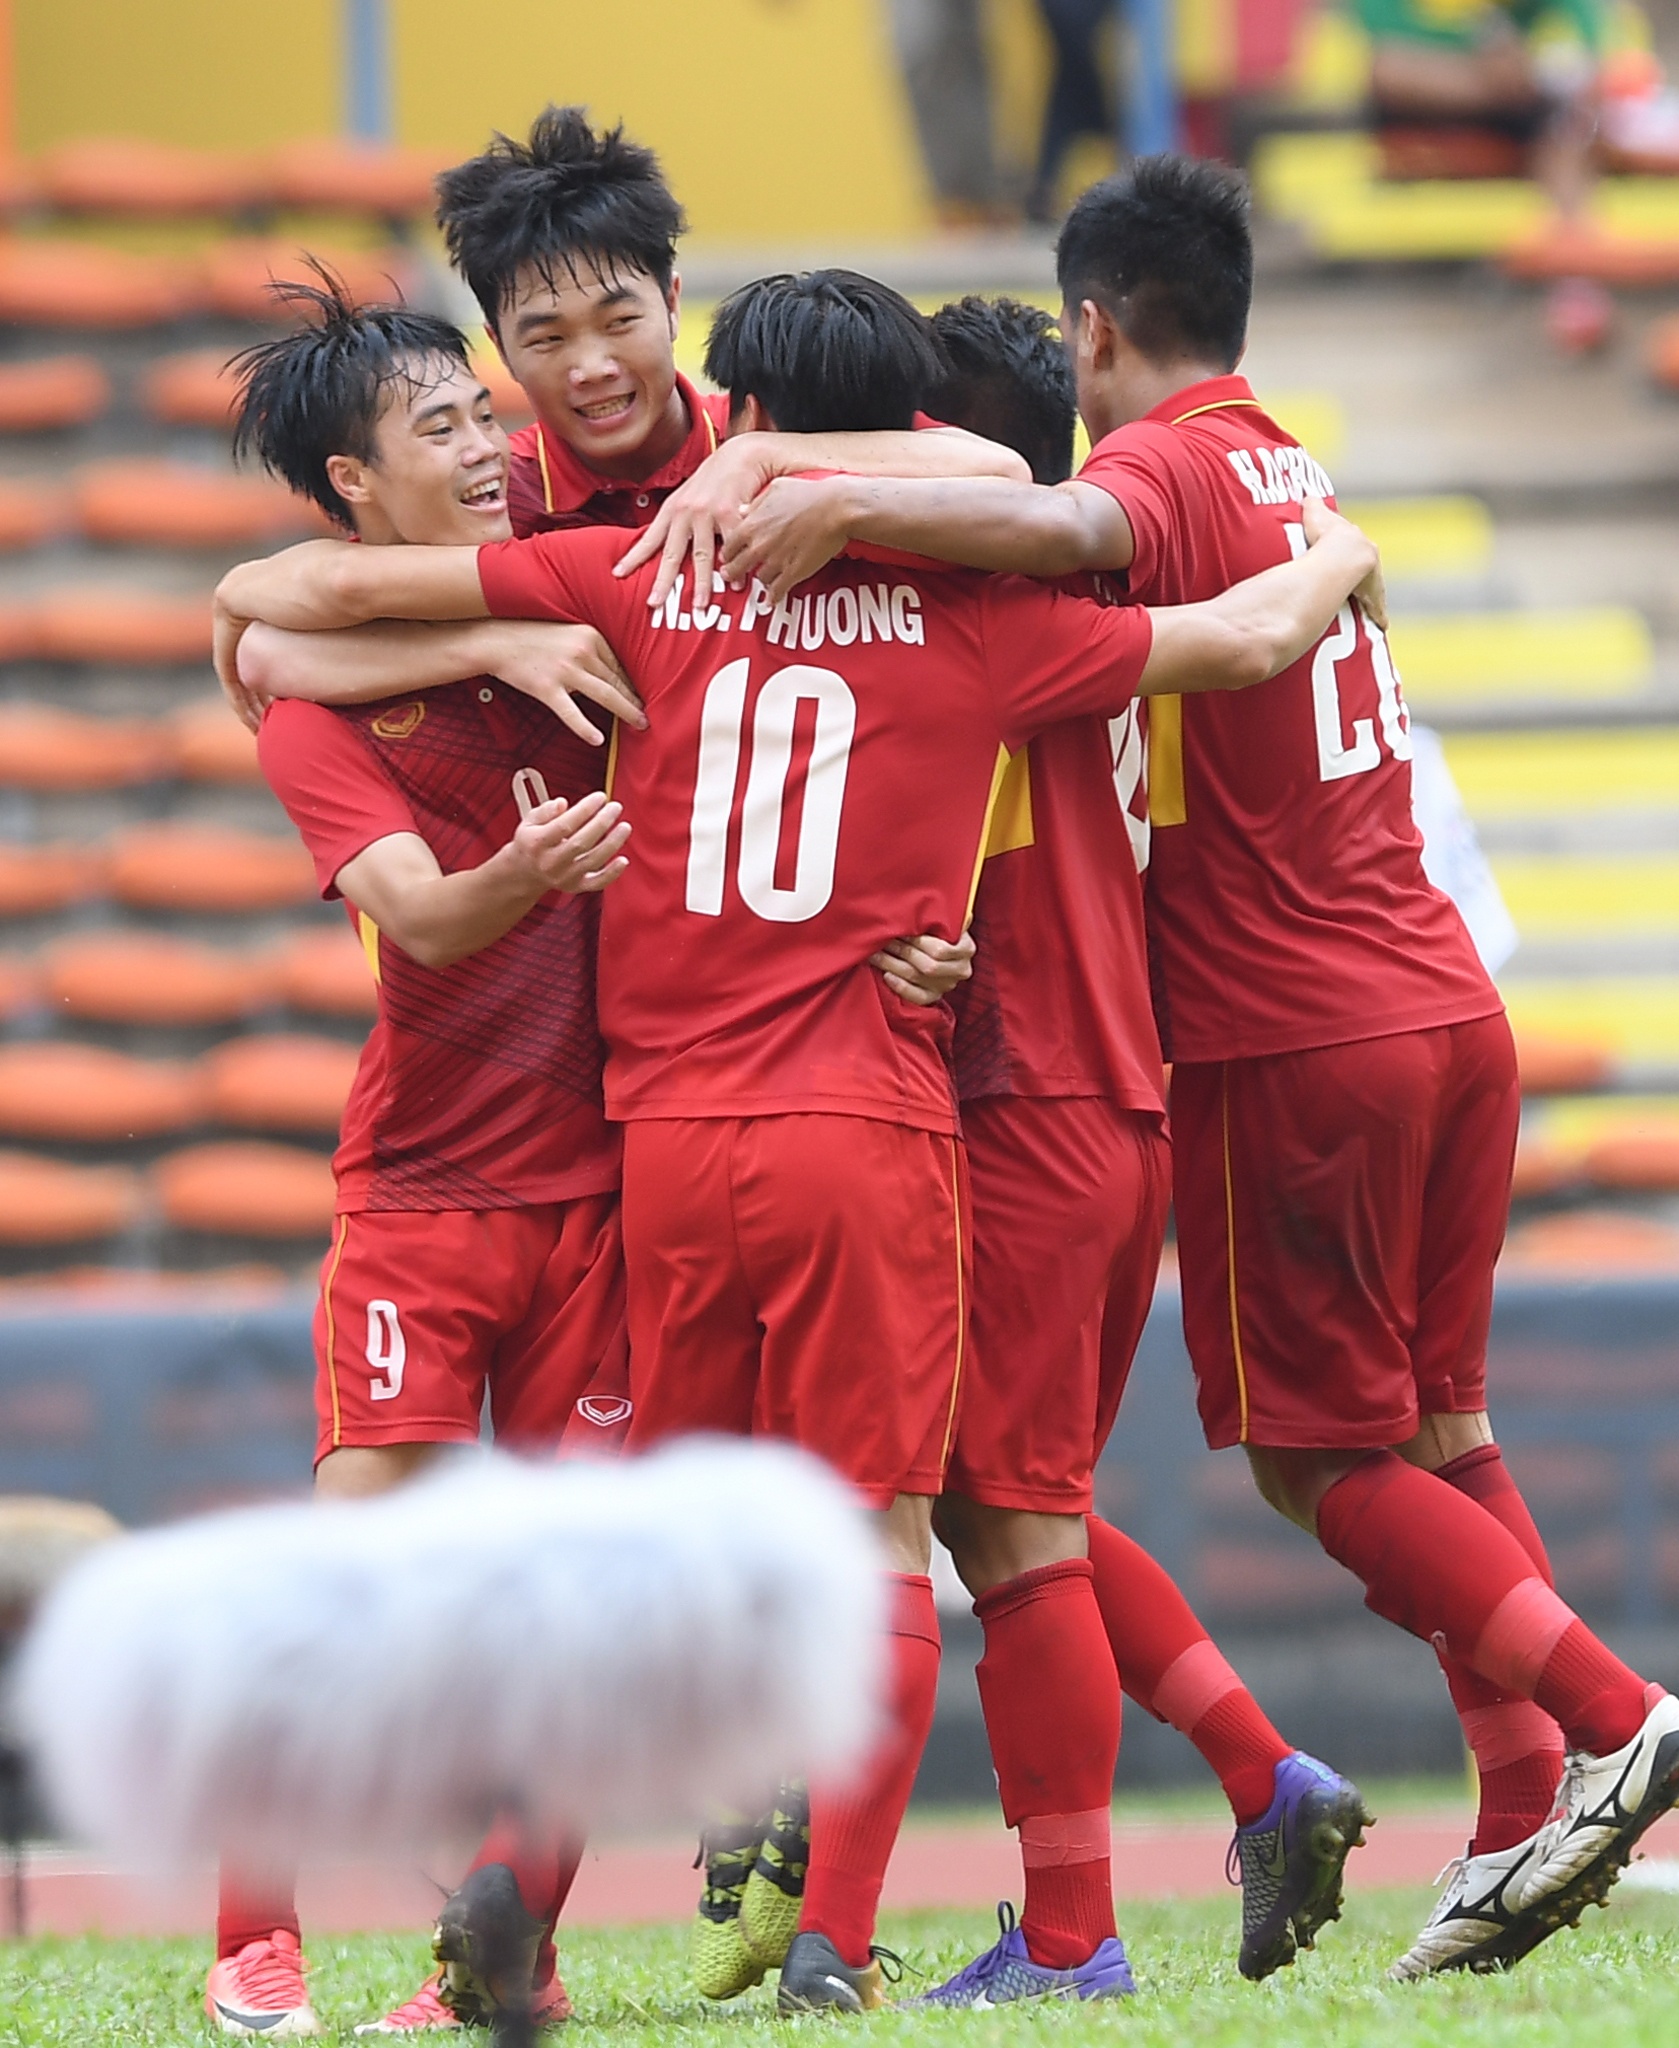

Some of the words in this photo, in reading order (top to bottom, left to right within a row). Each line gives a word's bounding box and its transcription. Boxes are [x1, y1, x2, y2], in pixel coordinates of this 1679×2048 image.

[739, 576, 926, 651] PHUONG
[685, 656, 857, 922] 10
[365, 1298, 406, 1401] 9
